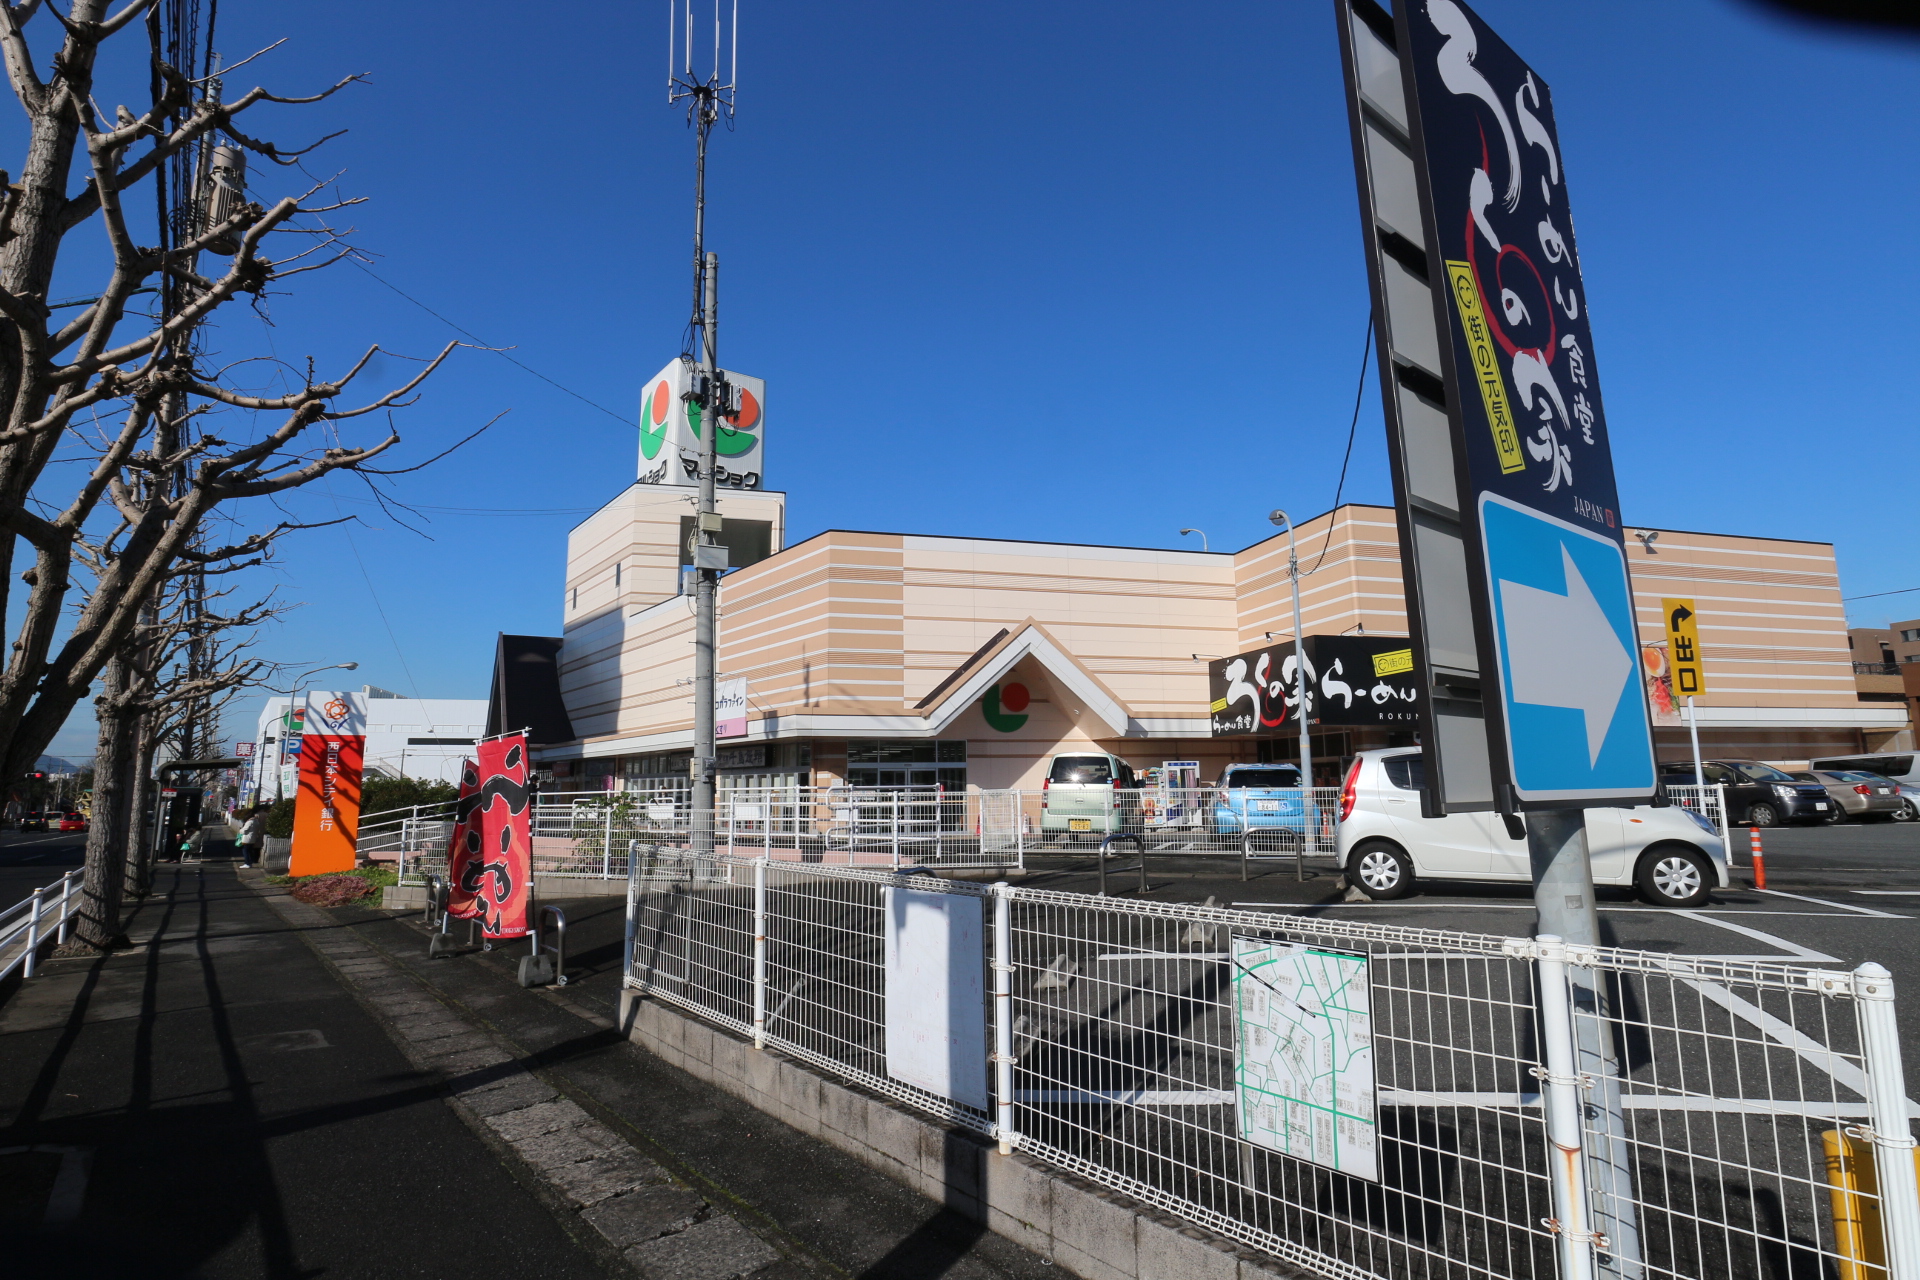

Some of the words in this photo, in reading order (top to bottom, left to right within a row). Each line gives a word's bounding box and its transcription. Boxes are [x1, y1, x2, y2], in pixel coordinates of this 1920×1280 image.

[682, 458, 759, 488] マショク
[1573, 495, 1604, 524] JAPAN
[1321, 657, 1417, 709] らーめん
[1674, 635, 1698, 692] 出口
[320, 741, 340, 832] 西日本シティ銀行
